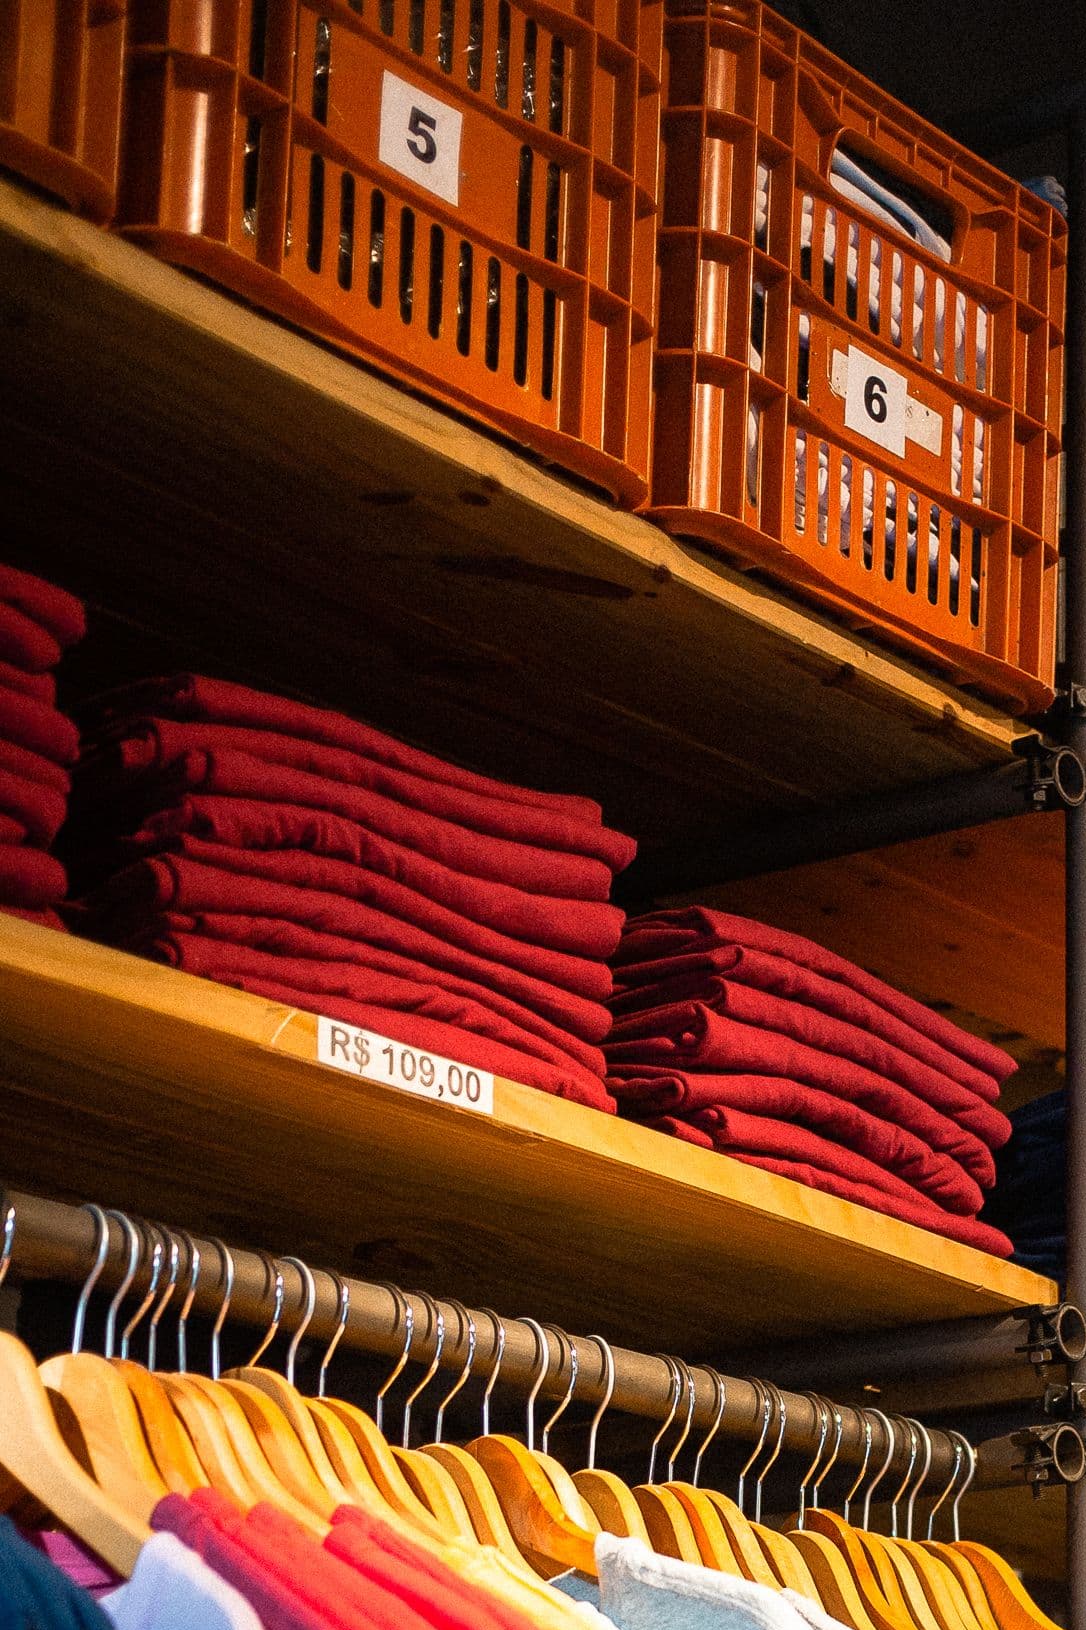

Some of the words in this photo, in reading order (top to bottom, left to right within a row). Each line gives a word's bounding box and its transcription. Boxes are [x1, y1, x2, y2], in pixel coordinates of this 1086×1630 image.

[407, 106, 437, 164] 5
[864, 376, 887, 424] 6
[330, 1025, 371, 1074] R$
[382, 1044, 481, 1102] 109,00
